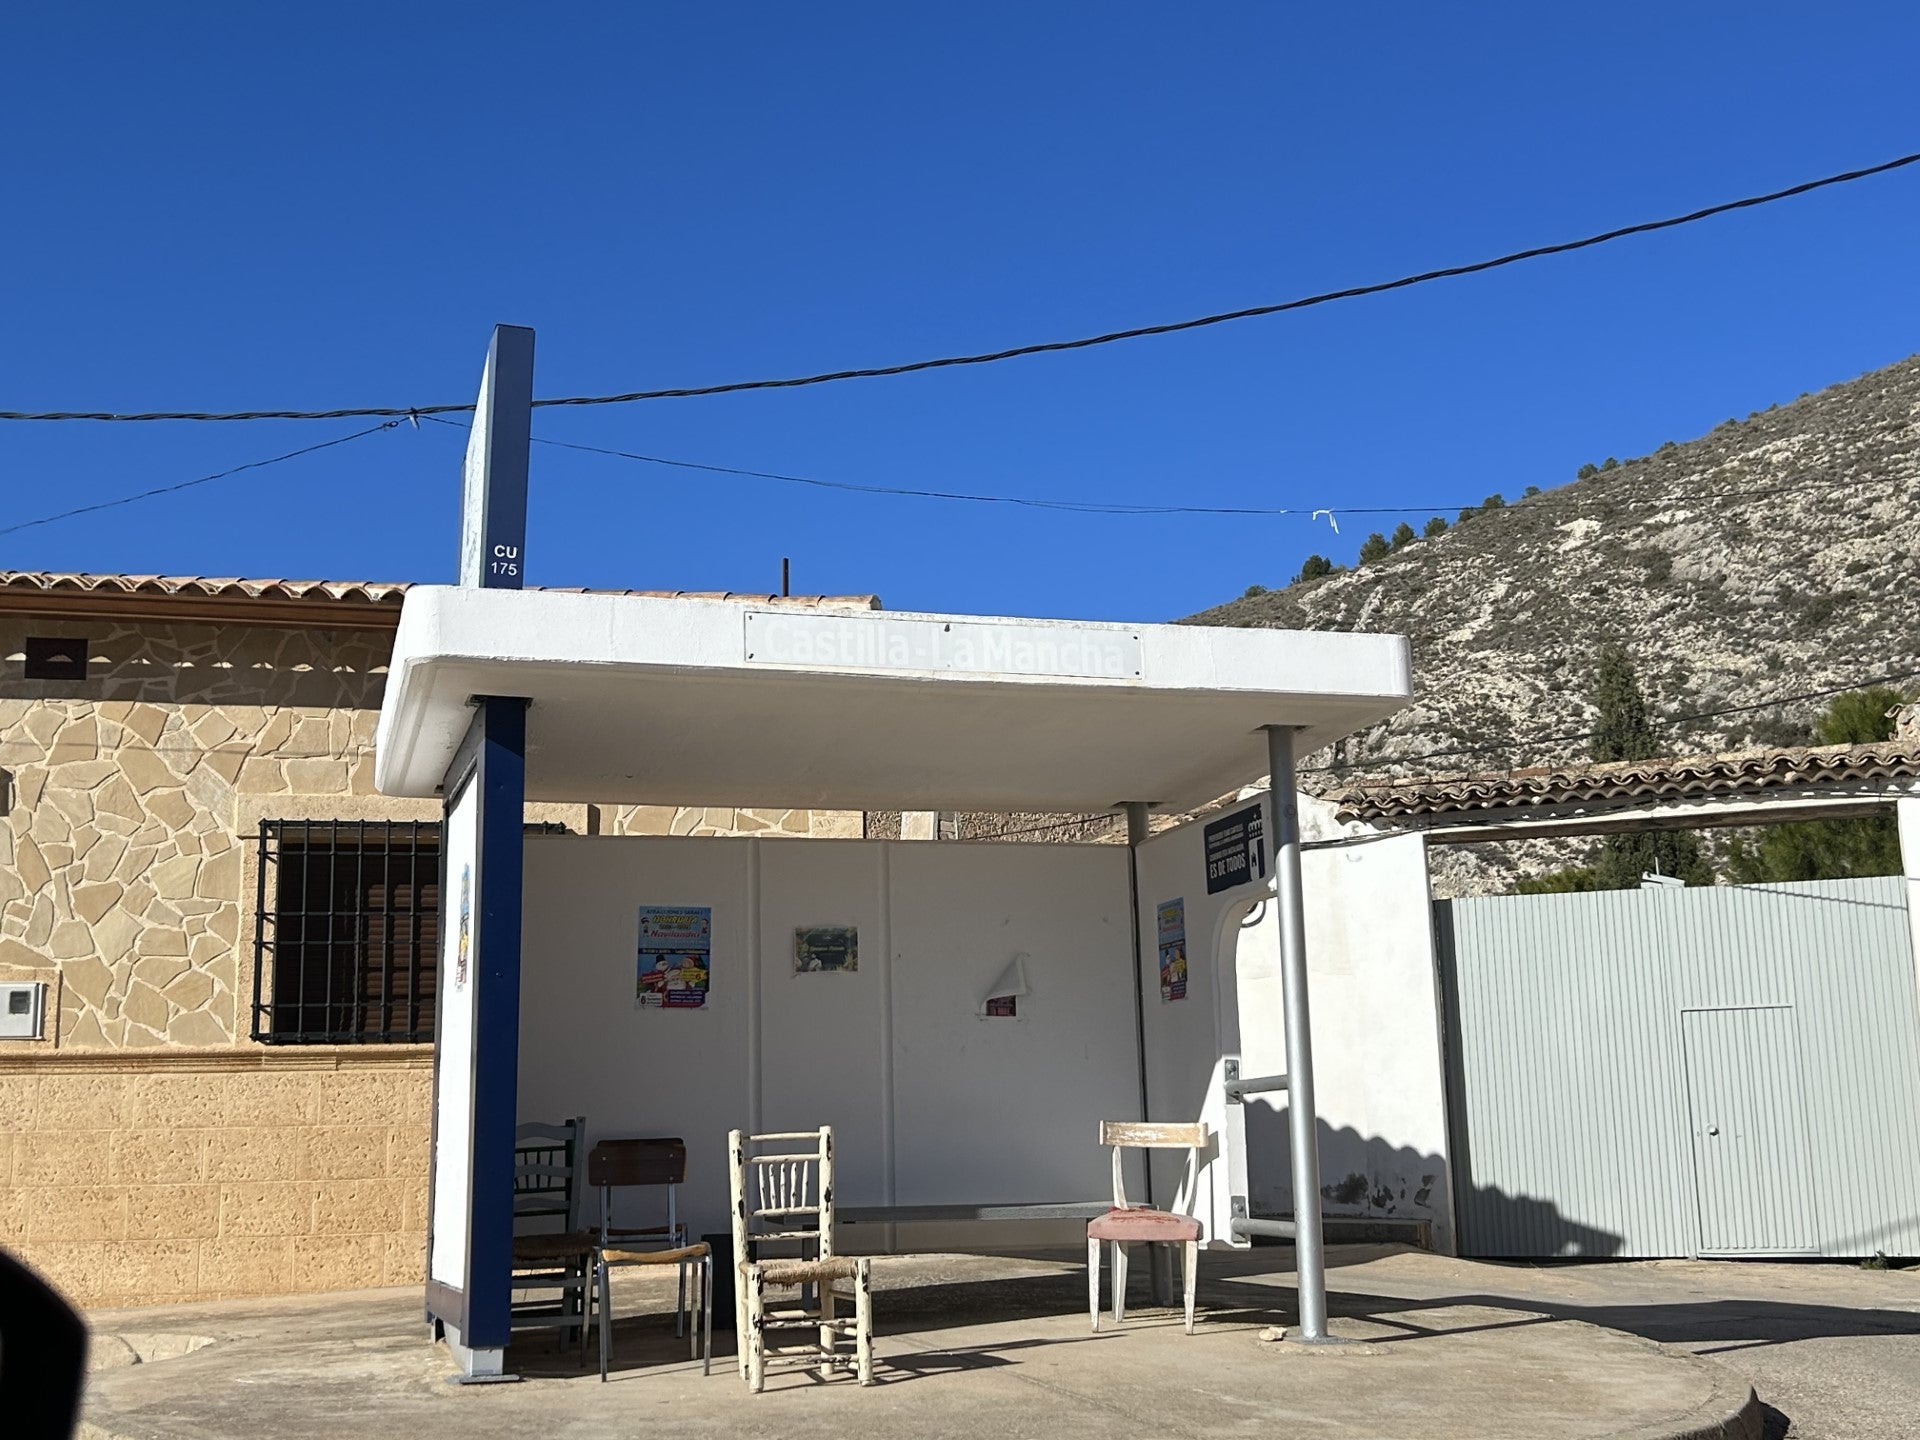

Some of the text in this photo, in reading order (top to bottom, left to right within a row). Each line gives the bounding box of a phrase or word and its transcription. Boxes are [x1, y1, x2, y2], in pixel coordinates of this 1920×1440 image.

[494, 544, 517, 559] CU
[491, 561, 517, 576] 175
[982, 629, 1124, 674] Mancha
